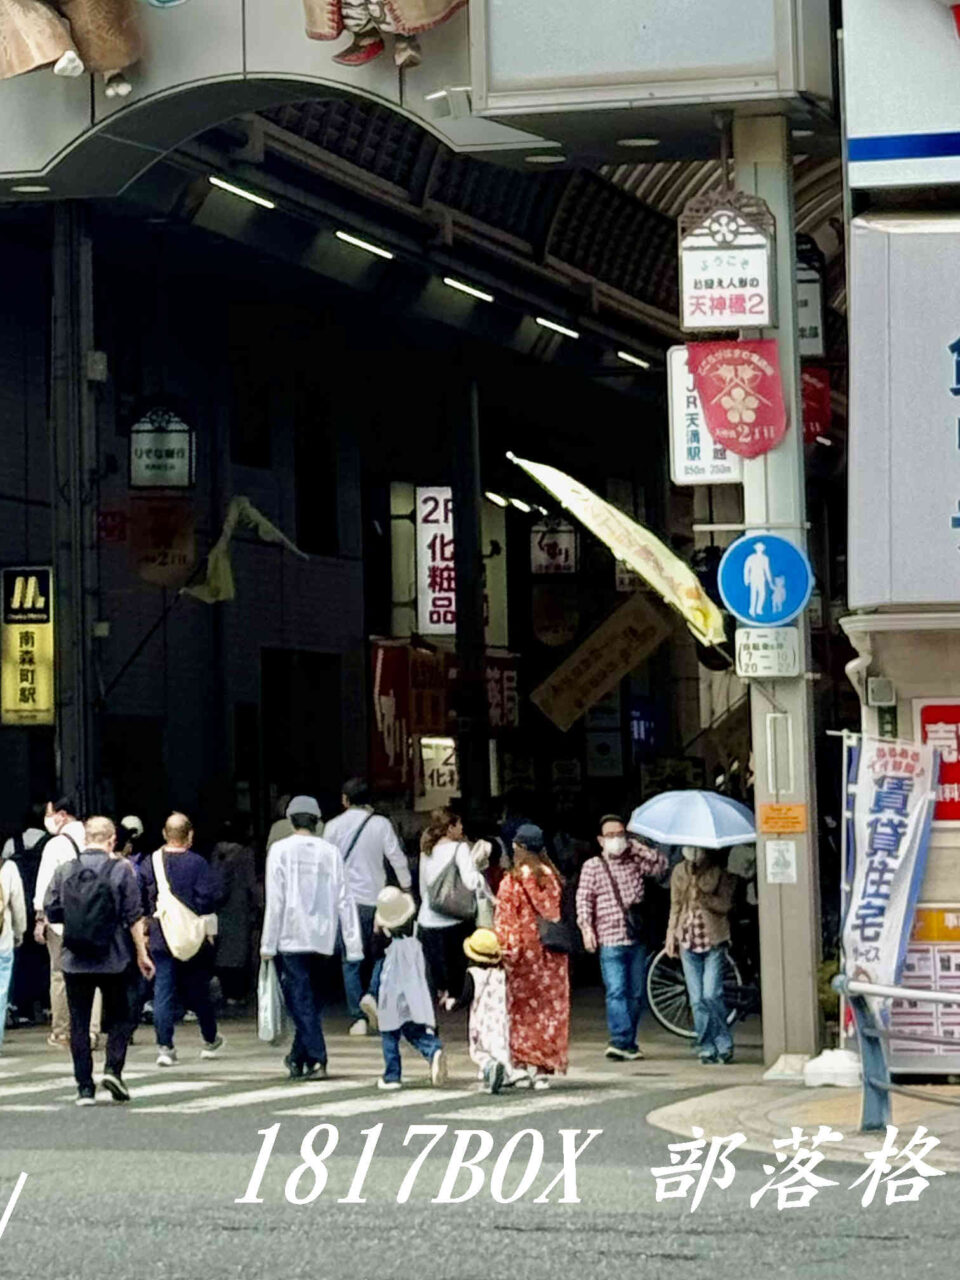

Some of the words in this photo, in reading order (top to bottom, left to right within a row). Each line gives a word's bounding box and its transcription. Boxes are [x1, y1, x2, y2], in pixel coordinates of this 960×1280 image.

[689, 293, 765, 316] 天神橋2
[427, 533, 456, 624] 化粧品
[18, 631, 36, 704] 南森町駅
[851, 774, 914, 943] 賃貸住宅
